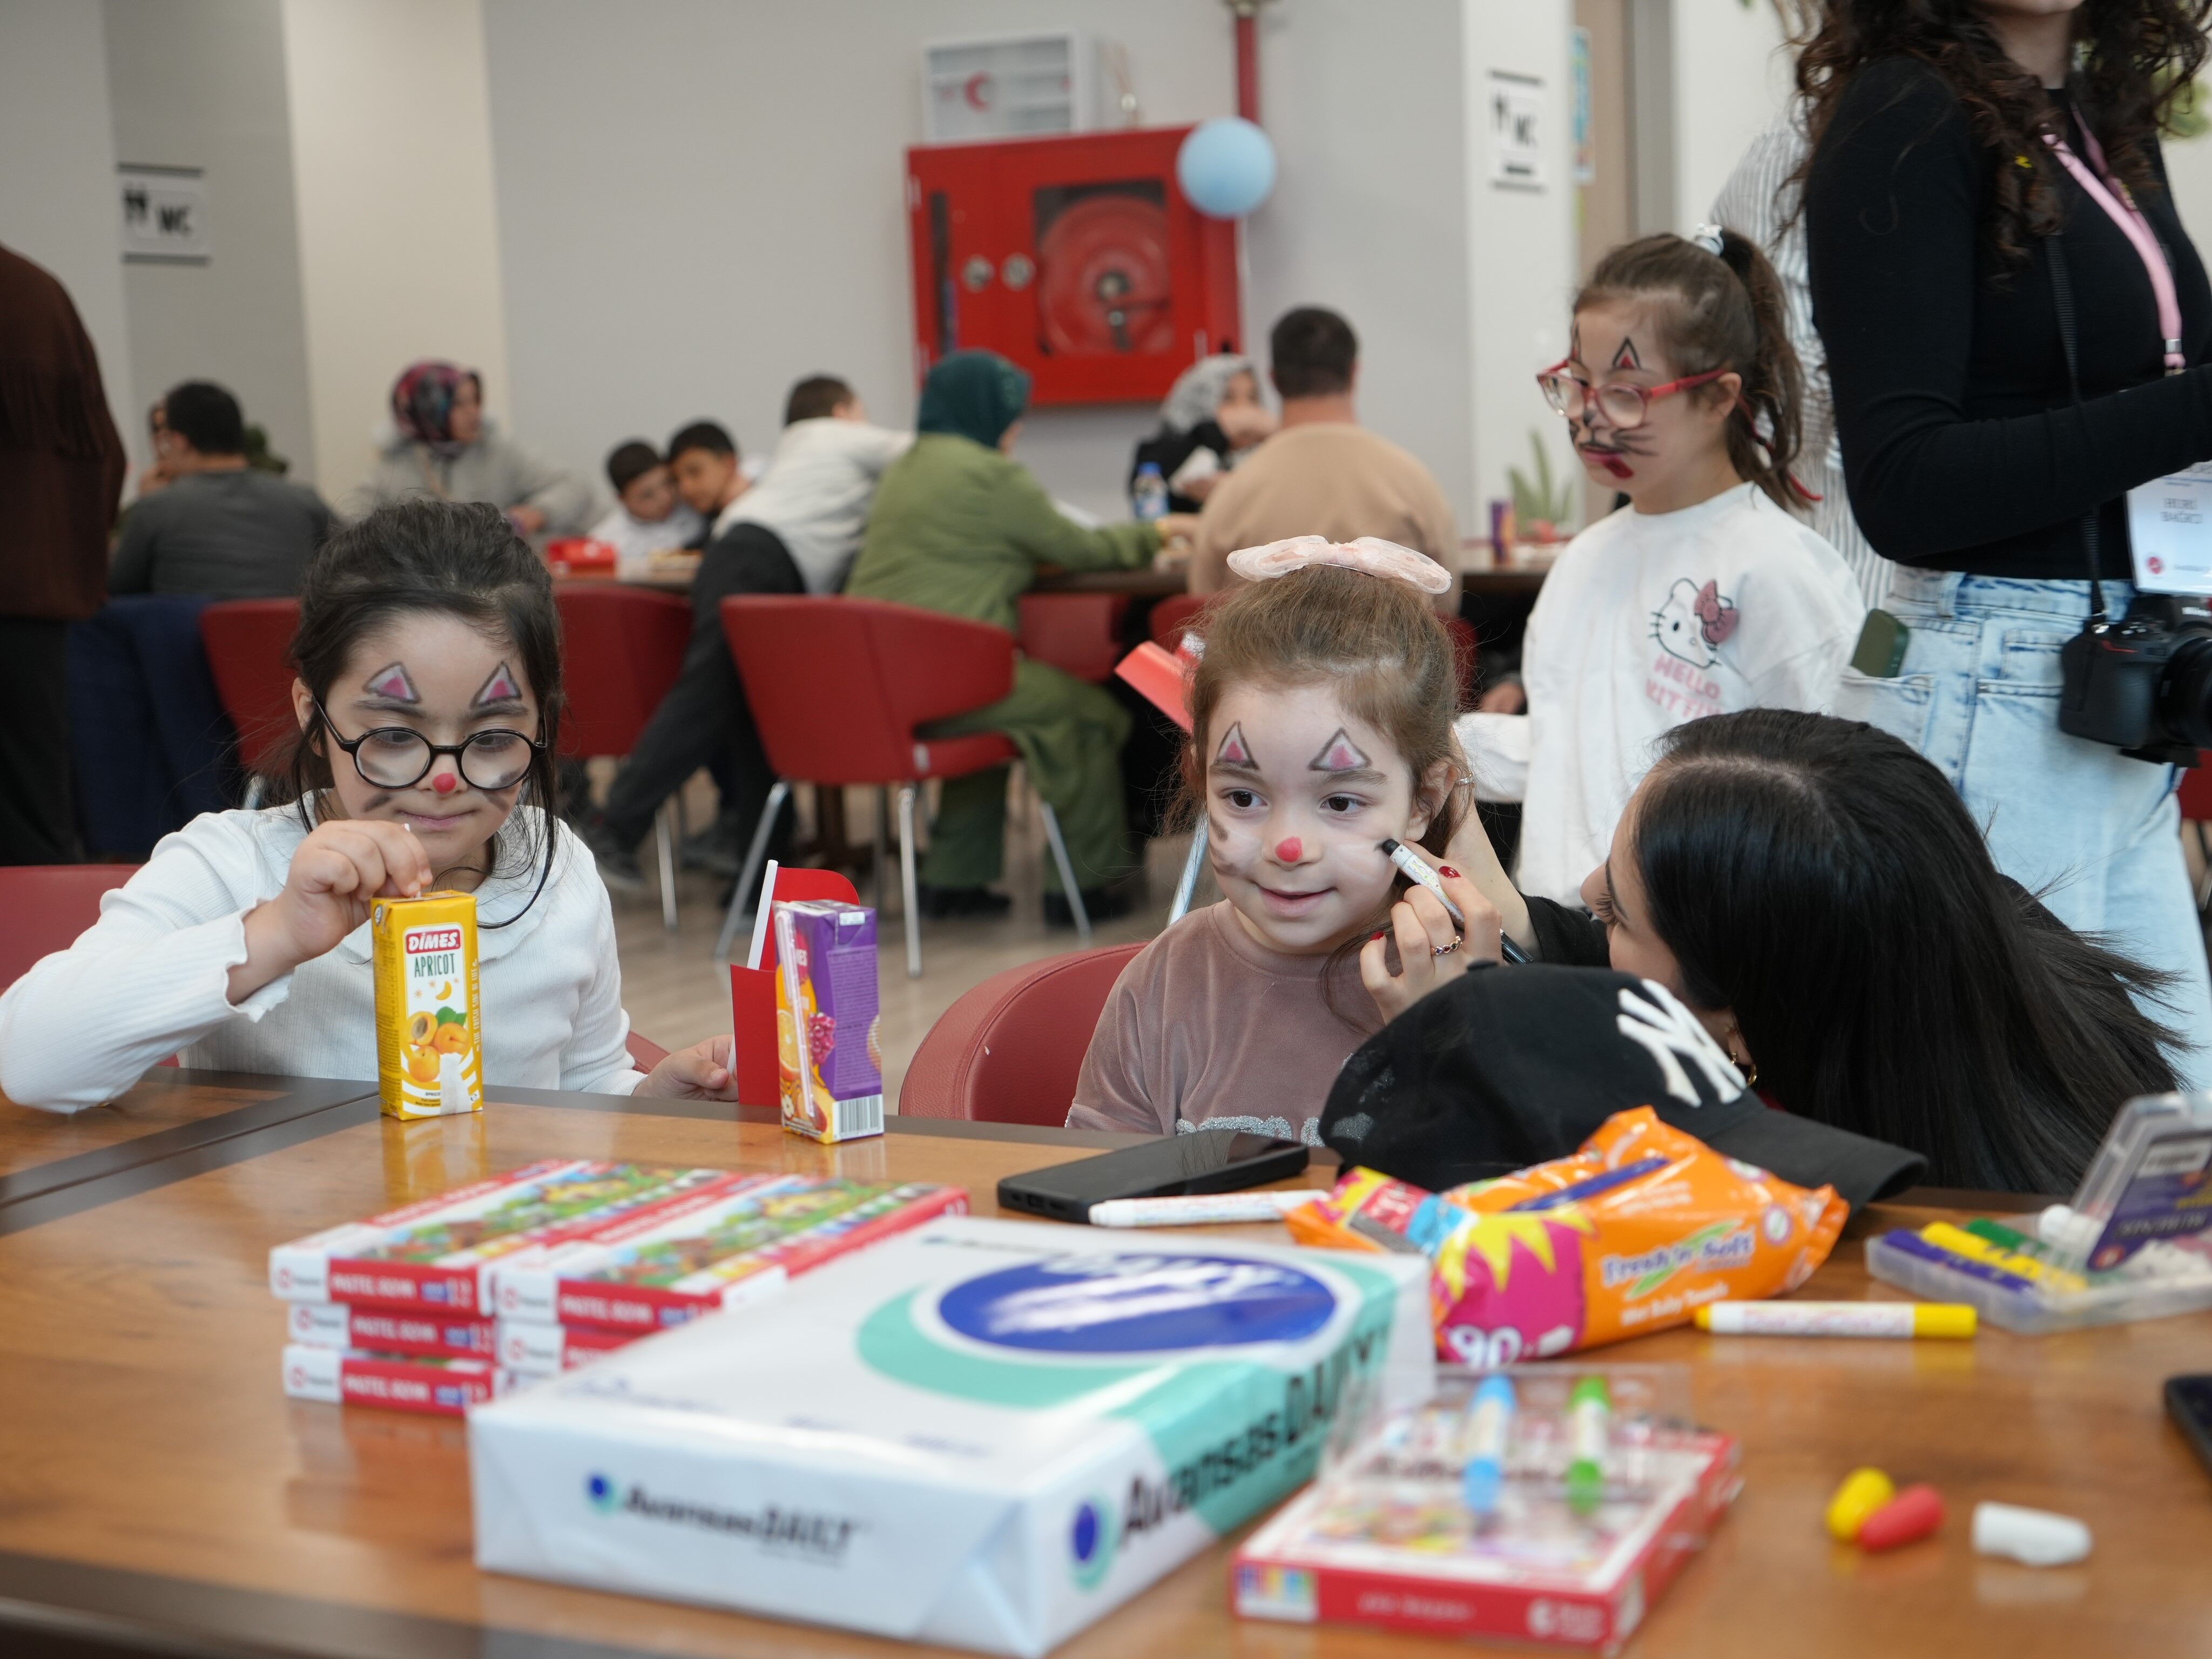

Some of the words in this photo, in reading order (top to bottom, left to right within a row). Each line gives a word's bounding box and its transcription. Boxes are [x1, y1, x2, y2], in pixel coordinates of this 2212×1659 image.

[1654, 653, 1721, 700] HELLO
[414, 953, 455, 978] APRICOT
[1616, 978, 1746, 1108] NY
